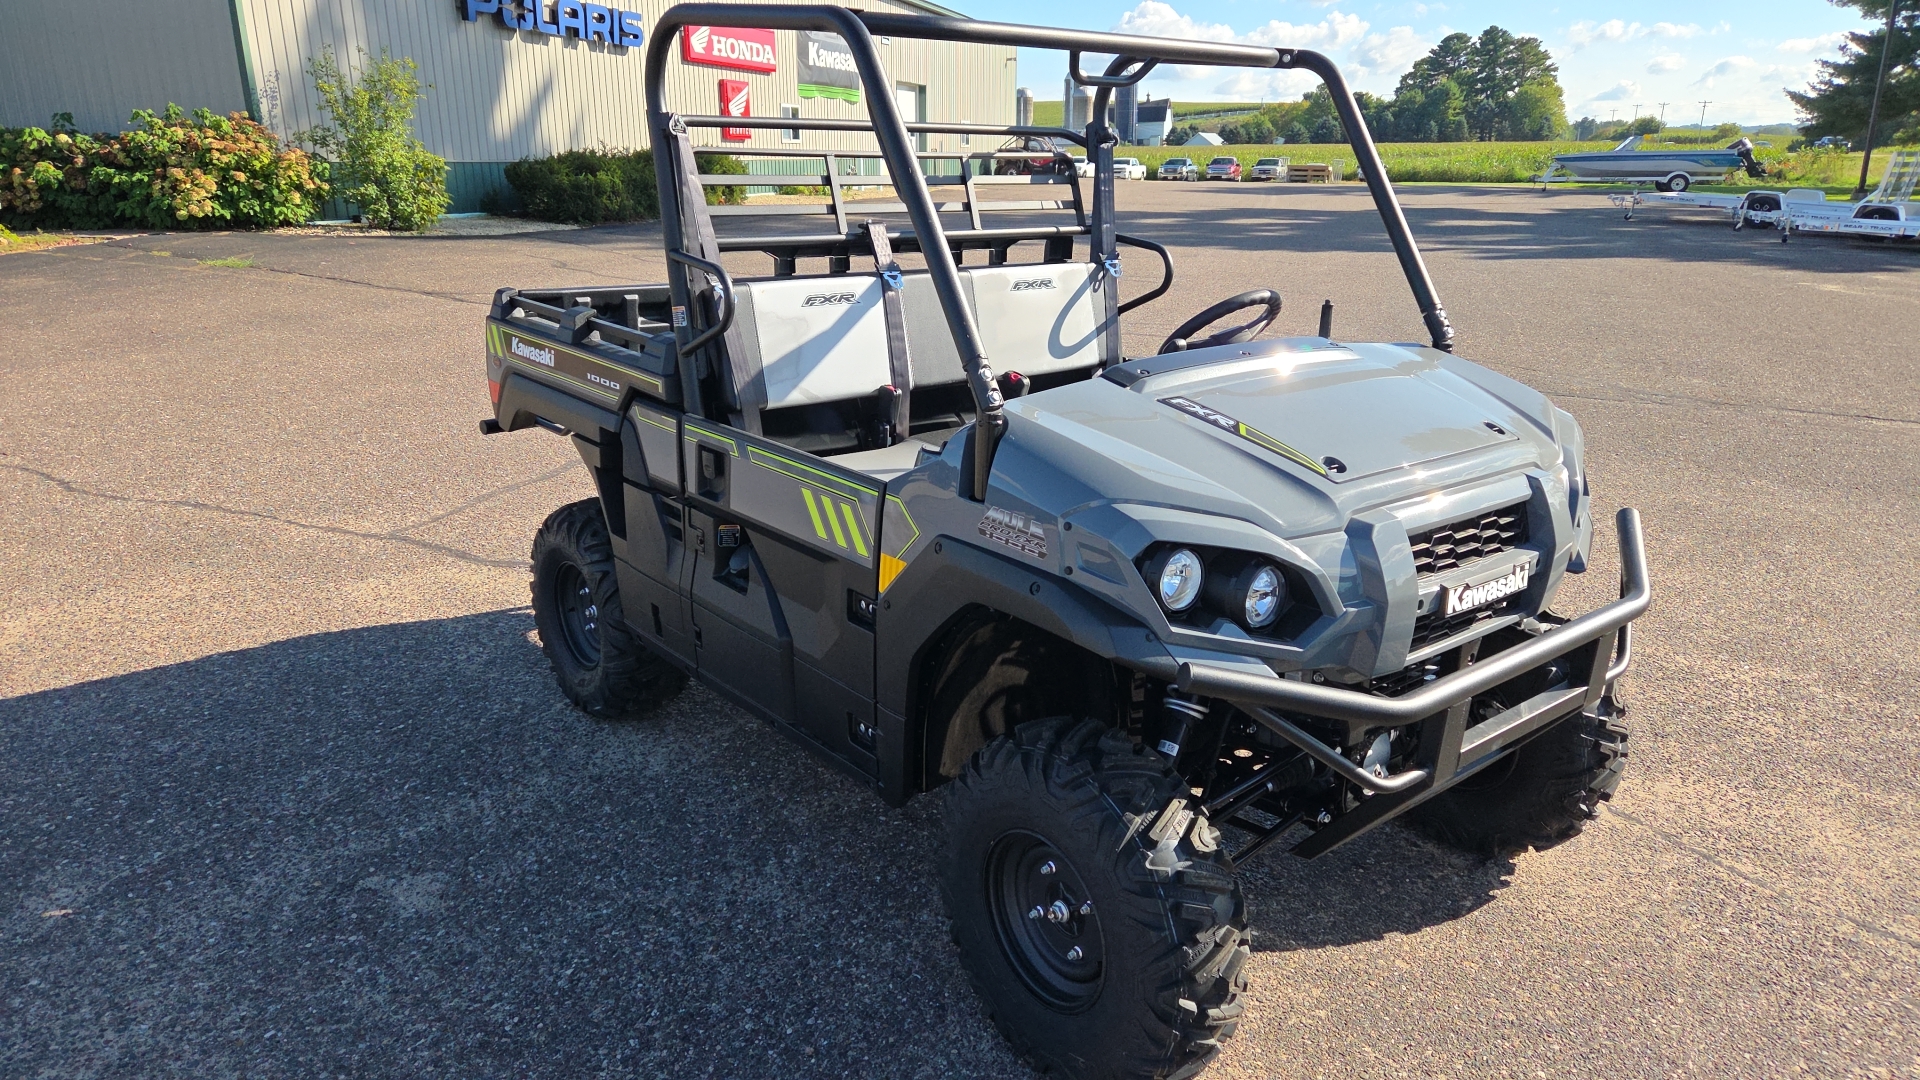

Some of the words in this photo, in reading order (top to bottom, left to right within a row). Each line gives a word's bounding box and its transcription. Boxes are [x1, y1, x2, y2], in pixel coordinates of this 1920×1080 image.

[465, 0, 644, 48] POLARIS
[711, 34, 776, 65] HONDA
[808, 41, 859, 73] Kawasak
[801, 291, 860, 308] FXR
[1009, 278, 1057, 292] FXR
[511, 336, 555, 367] Kawasaki
[586, 372, 620, 390] 1000
[1164, 397, 1237, 430] FXR
[983, 506, 1046, 543] MULE
[1447, 563, 1530, 615] Kawasaki
